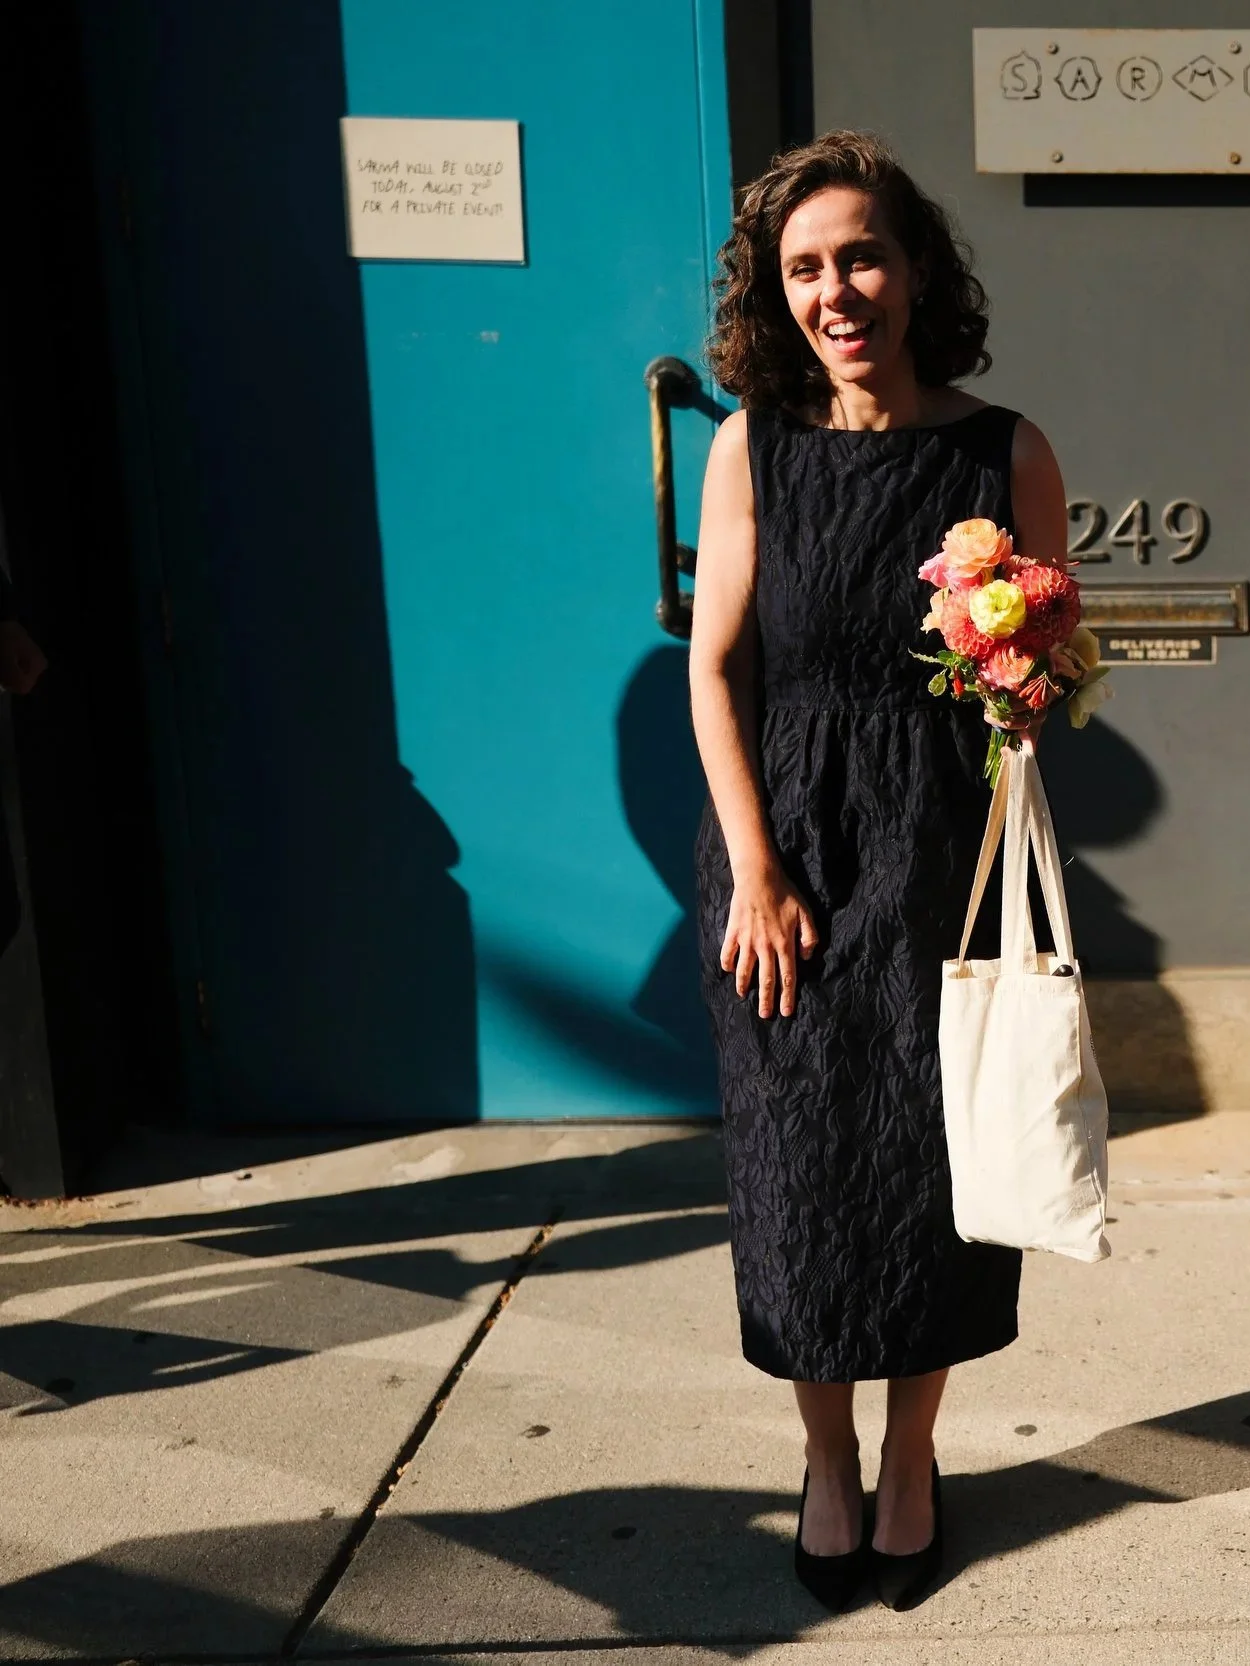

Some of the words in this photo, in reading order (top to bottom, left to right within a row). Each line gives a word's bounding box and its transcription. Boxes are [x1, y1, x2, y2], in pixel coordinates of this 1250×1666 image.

[357, 159, 400, 175] SARMA
[406, 162, 434, 175] WILL
[441, 160, 456, 175] BE
[464, 160, 503, 177] CLOSED
[422, 180, 463, 196] AUGUST
[362, 200, 383, 214] FOR
[390, 200, 399, 213] A
[407, 200, 455, 215] PRIVATE
[1067, 498, 1209, 564] 249
[1109, 639, 1201, 650] DELIVERIES
[1127, 650, 1144, 659] IN
[1147, 650, 1190, 659] REAR
